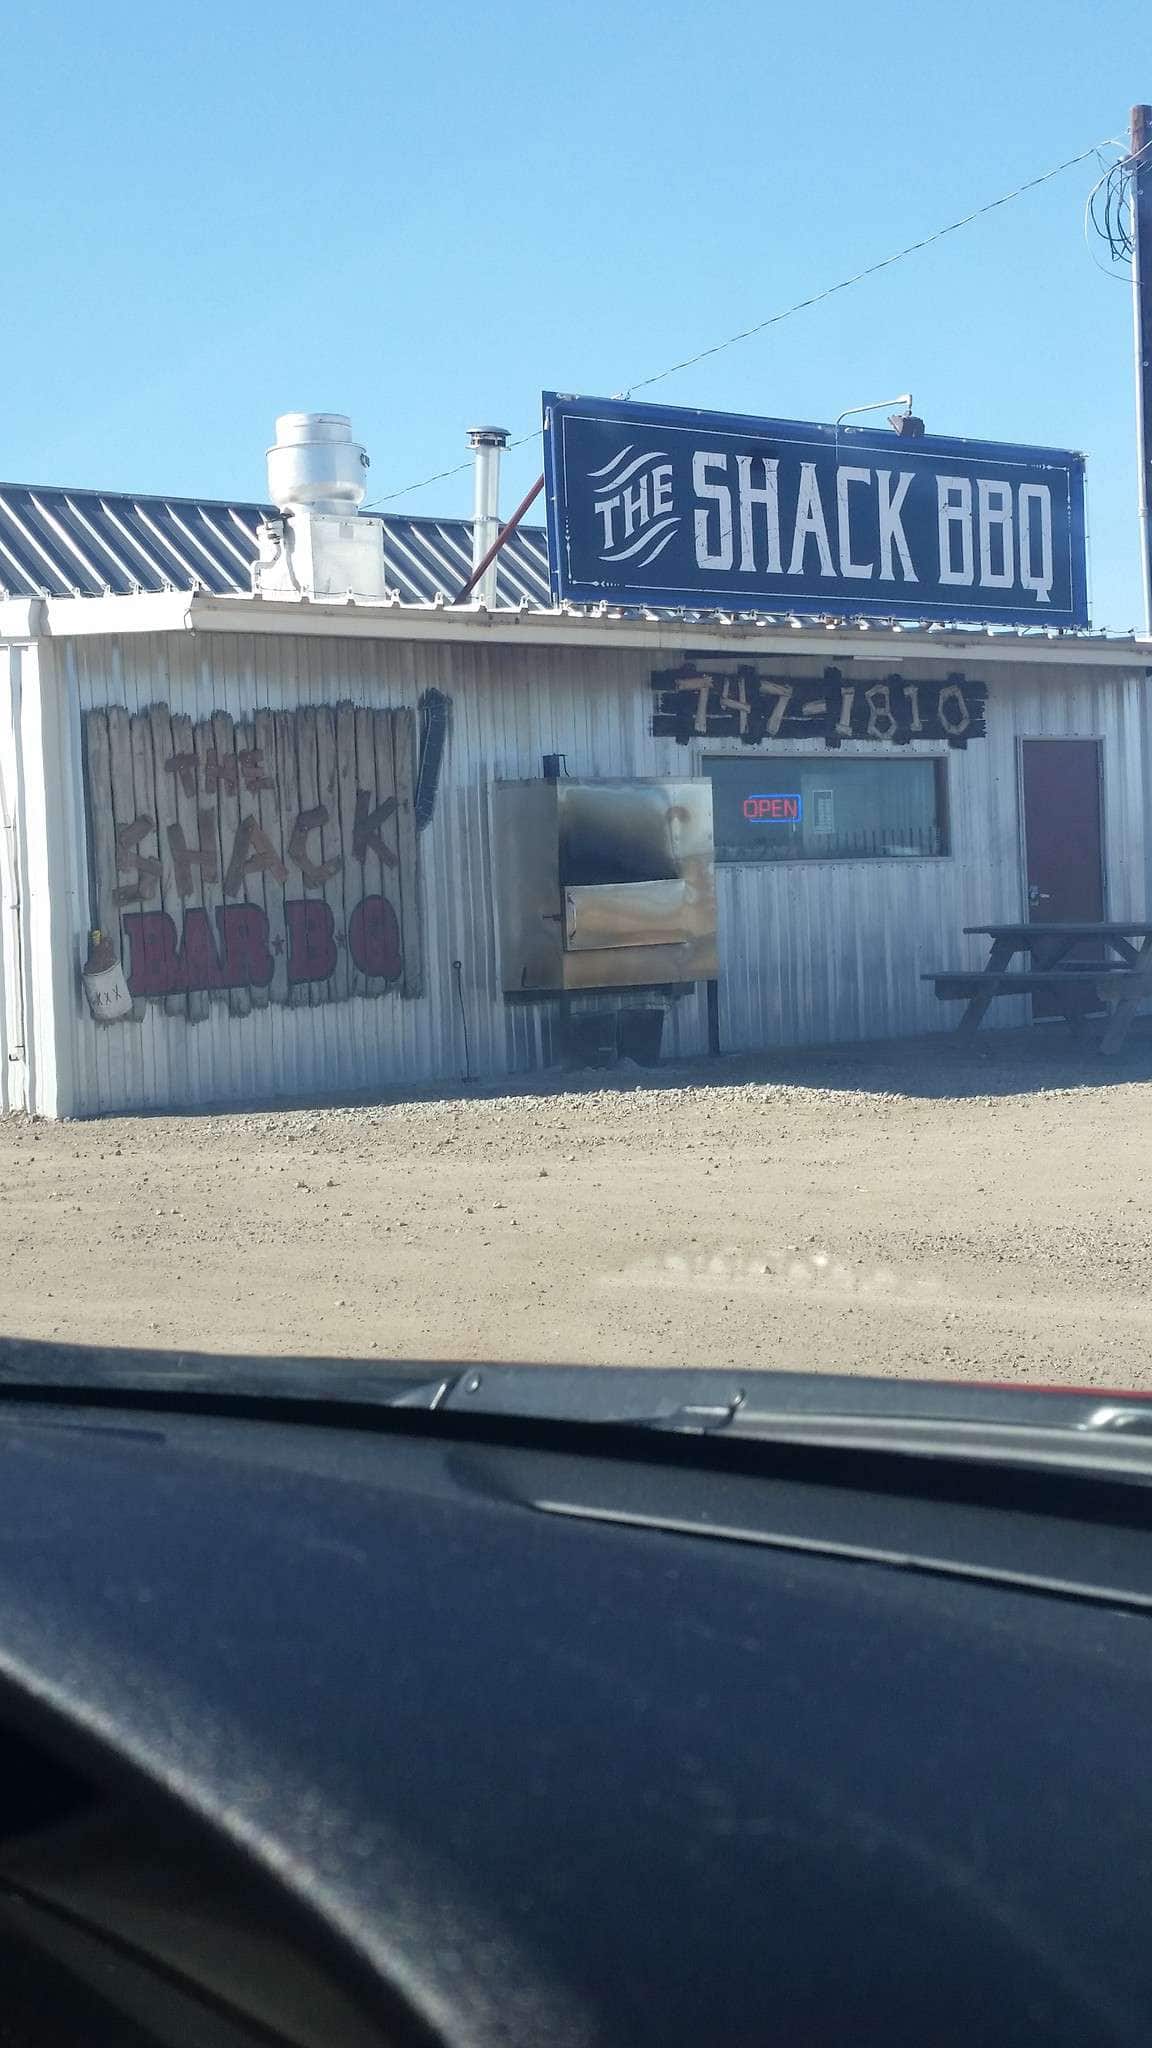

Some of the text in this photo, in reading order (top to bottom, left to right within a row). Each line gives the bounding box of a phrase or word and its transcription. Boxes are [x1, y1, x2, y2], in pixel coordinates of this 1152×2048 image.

[594, 450, 1054, 602] THE SHACK BBQ
[675, 673, 970, 739] 747-1810
[165, 748, 276, 798] THE
[743, 799, 798, 819] OPEN
[112, 790, 408, 907] SHACK
